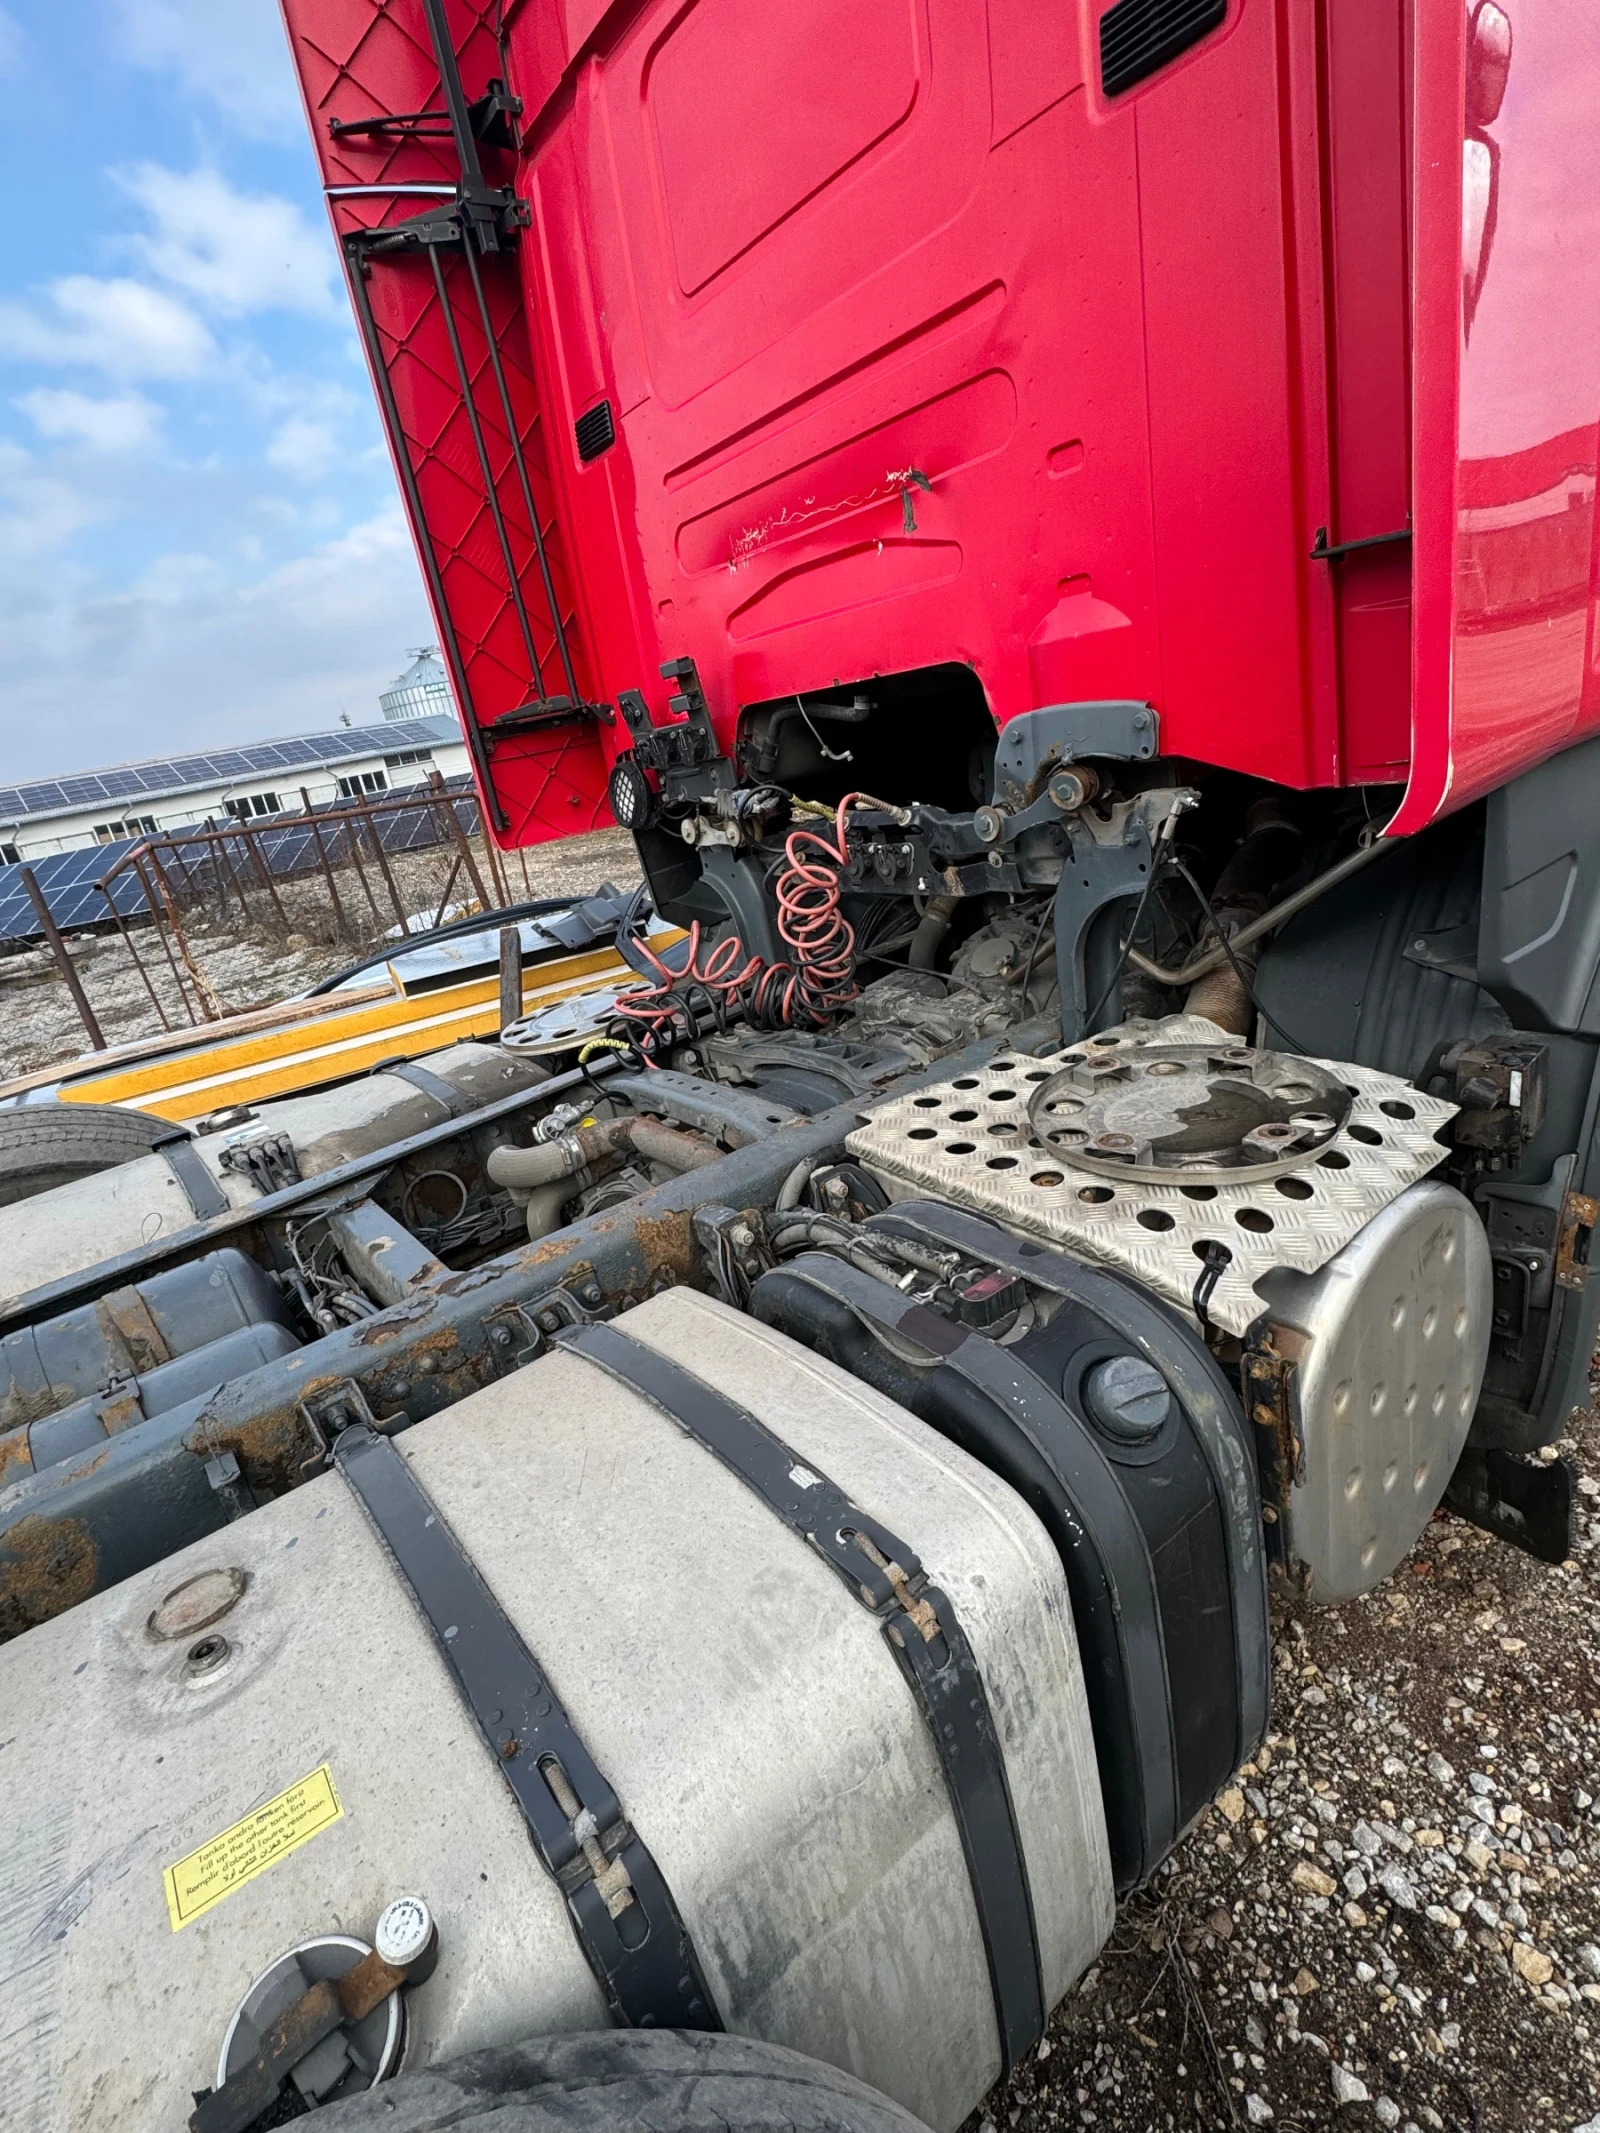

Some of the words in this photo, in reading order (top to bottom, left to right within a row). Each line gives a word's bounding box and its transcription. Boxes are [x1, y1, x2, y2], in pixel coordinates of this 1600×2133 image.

[198, 1842, 226, 1863] Tanka
[227, 1824, 254, 1844] andra
[200, 1860, 214, 1874] Fill
[216, 1853, 228, 1864] up
[230, 1842, 244, 1854] the
[245, 1825, 267, 1844] other
[269, 1812, 289, 1828] tank
[290, 1799, 306, 1813] first
[186, 1870, 219, 1896] Remplir
[222, 1843, 256, 1872] d'abord
